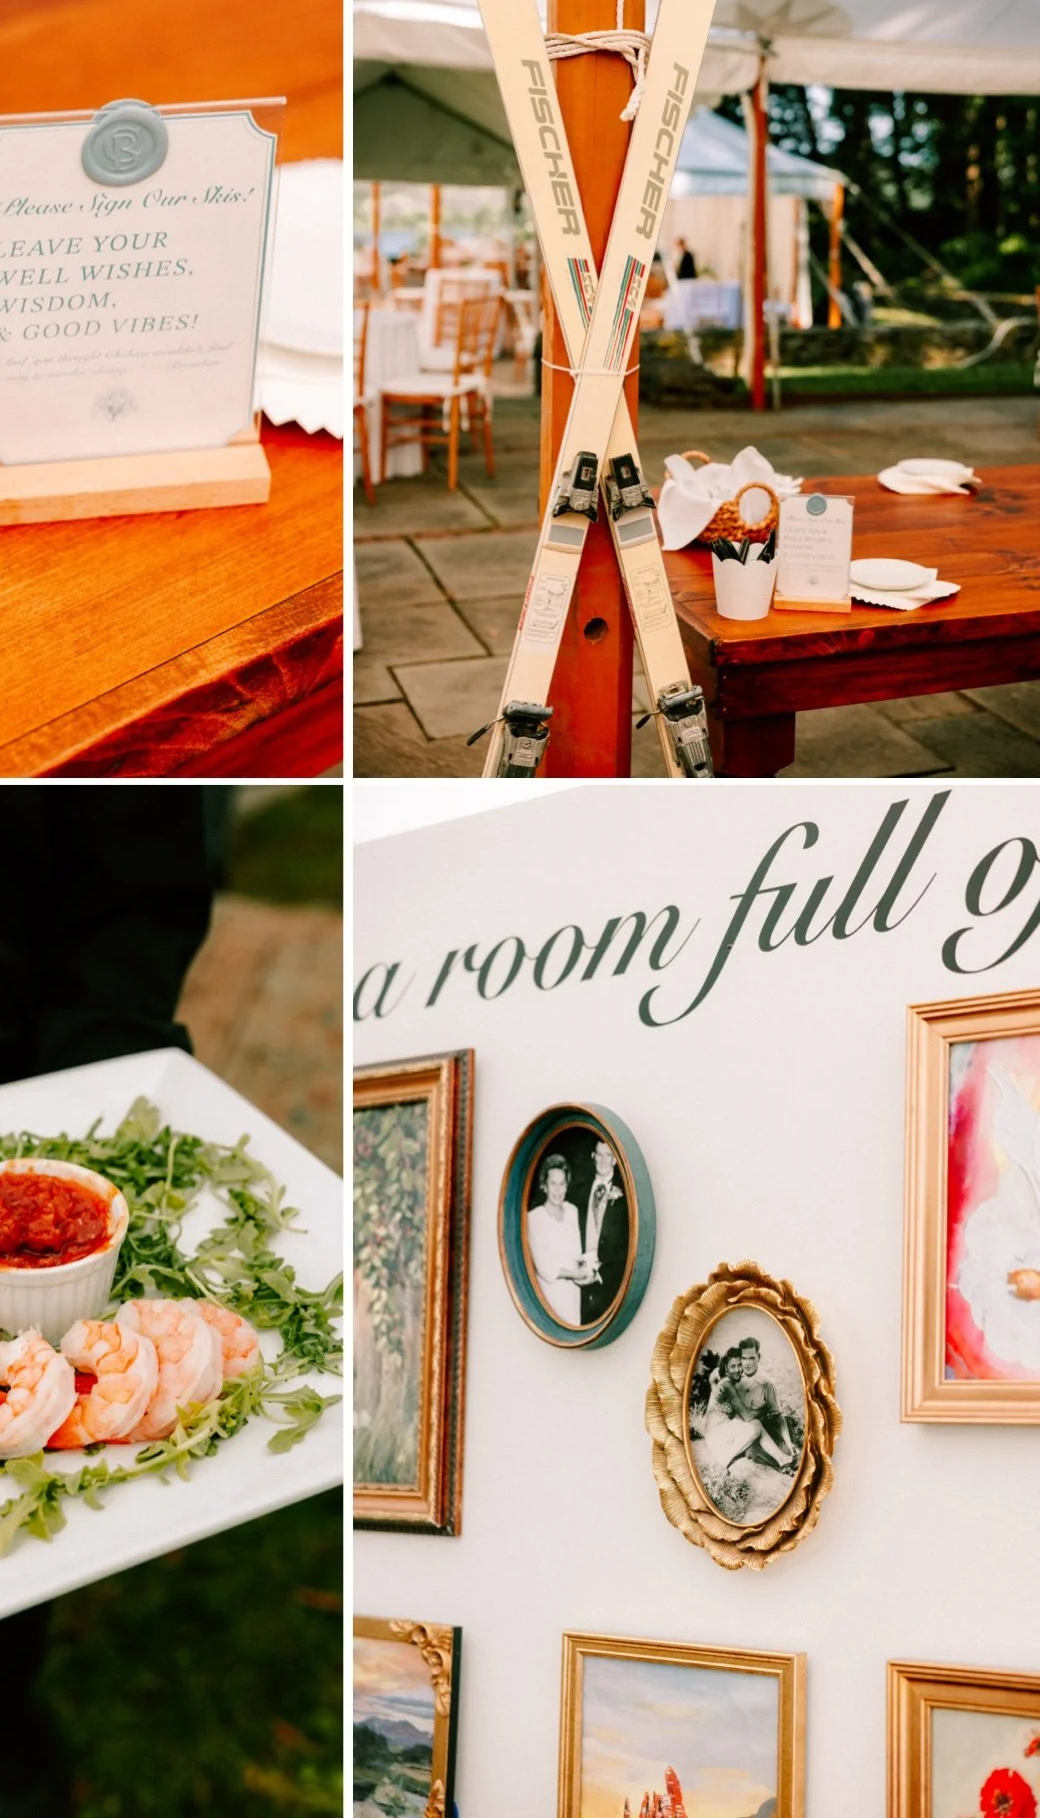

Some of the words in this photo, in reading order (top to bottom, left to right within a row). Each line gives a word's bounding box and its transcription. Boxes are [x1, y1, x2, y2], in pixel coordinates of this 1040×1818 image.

[521, 59, 581, 236] FISCHER
[635, 62, 690, 240] FISCHER
[79, 193, 134, 219] Sign
[142, 187, 187, 208] Our
[192, 185, 255, 205] Skis!
[92, 231, 168, 253] YOUR
[80, 258, 194, 281] WISHES,
[23, 320, 101, 340] GOOD
[112, 314, 199, 333] VIBES!
[353, 962, 417, 1022] a
[425, 904, 701, 1008] room
[638, 789, 953, 1027] full
